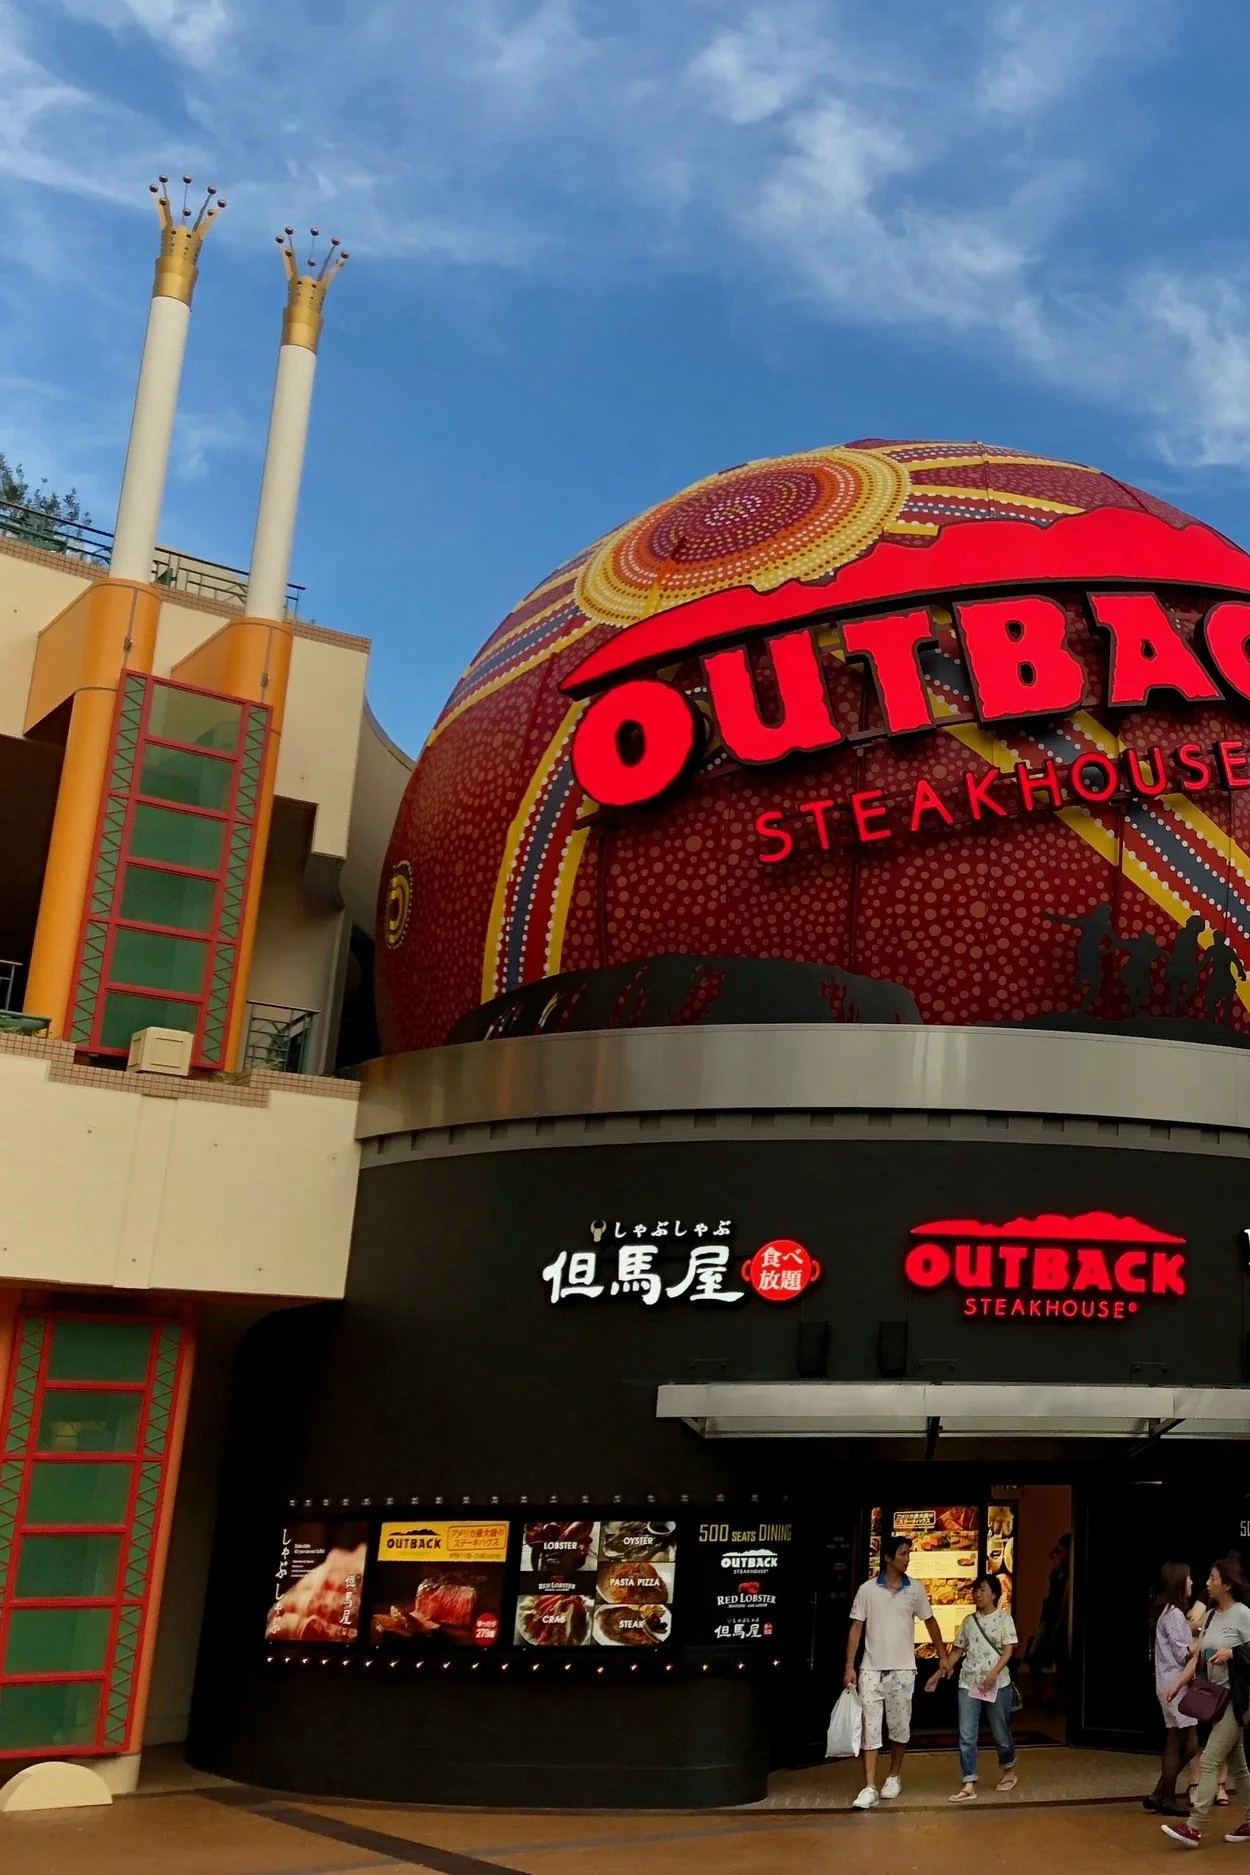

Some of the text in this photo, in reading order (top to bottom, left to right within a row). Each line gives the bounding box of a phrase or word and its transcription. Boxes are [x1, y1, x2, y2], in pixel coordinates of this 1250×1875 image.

[613, 1219, 732, 1238] しゃぶしゃぶ
[760, 1246, 804, 1268] 食べ
[542, 1244, 745, 1305] 但馬屋
[905, 1243, 1186, 1294] OUTBACK
[758, 1269, 803, 1291] 放題
[699, 1523, 792, 1542] 500 SEATS DINING
[386, 1538, 442, 1549] OUTBACK
[543, 1541, 578, 1550] LOBSTER
[623, 1536, 654, 1546] OYSTER
[720, 1557, 779, 1569] OUTBACK
[609, 1577, 661, 1587] PASTA PIZZA
[716, 1595, 739, 1606] RED
[740, 1593, 777, 1605] LOBSTER
[619, 1619, 644, 1628] STEAK
[714, 1623, 763, 1639] 但馬屋
